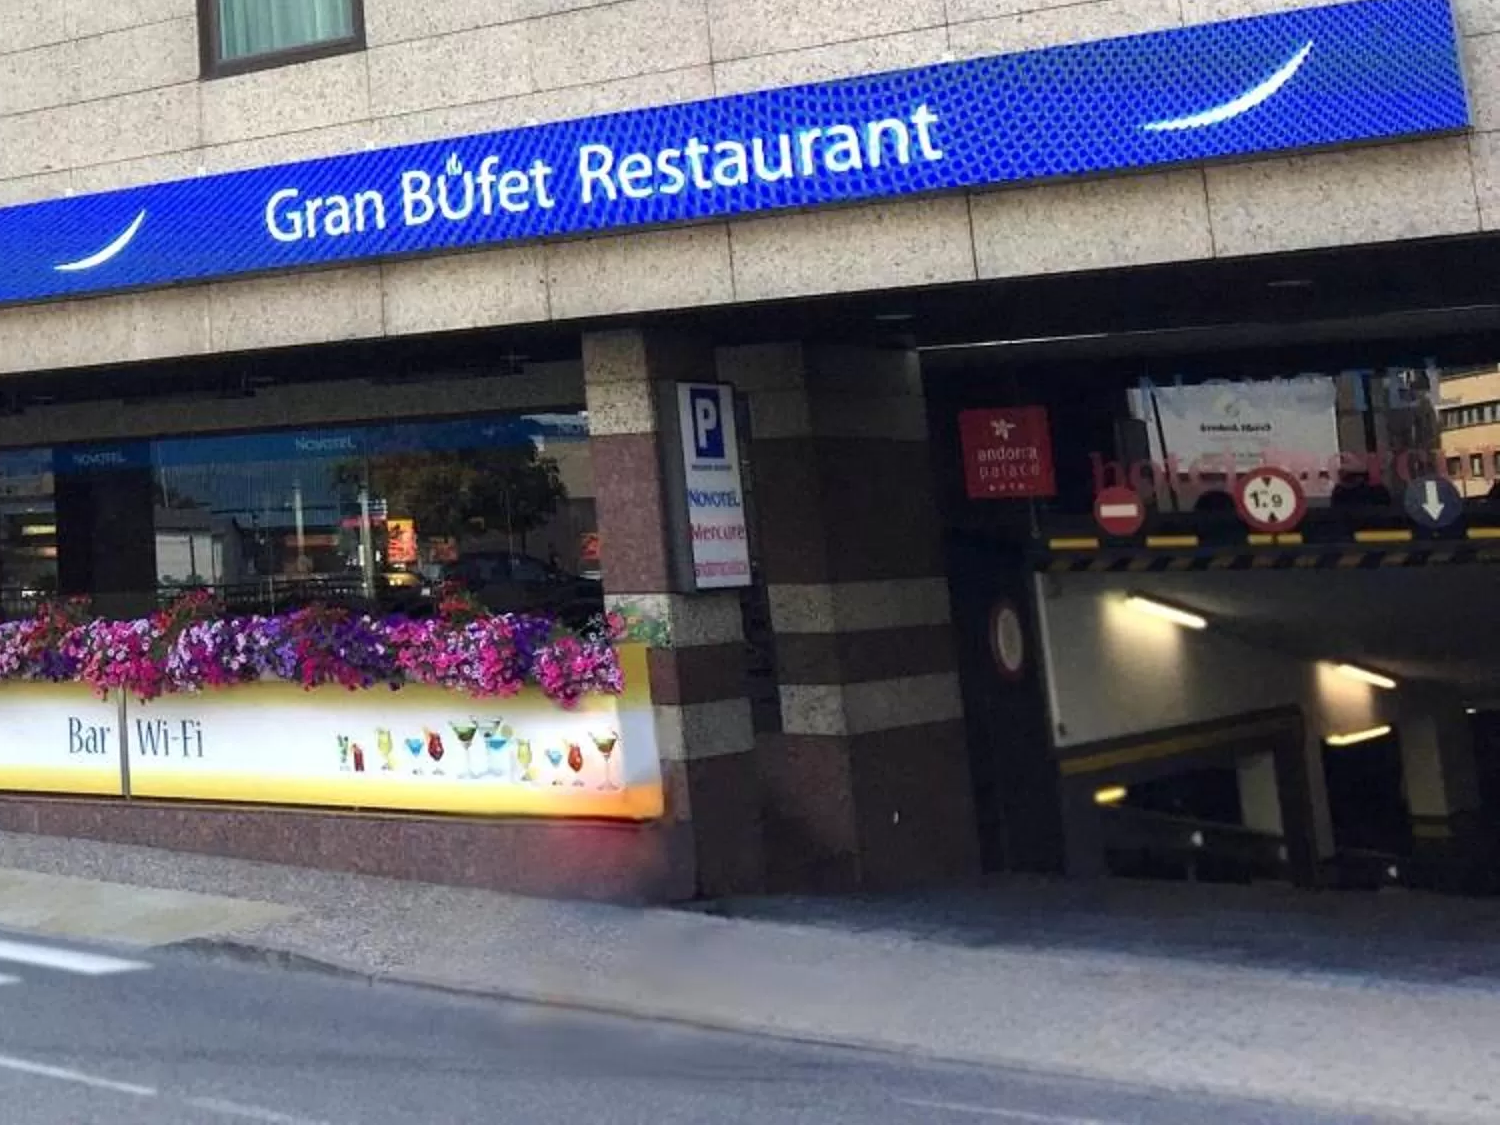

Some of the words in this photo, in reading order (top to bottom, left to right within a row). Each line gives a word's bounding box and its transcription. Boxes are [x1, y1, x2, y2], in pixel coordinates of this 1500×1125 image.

[265, 188, 386, 243] Gran
[577, 103, 944, 204] Restaurant
[695, 398, 717, 449] P
[977, 446, 1037, 461] andorra
[688, 488, 741, 507] NOVOTEL
[689, 524, 746, 543] Mercure
[68, 716, 111, 754] Bar
[136, 718, 204, 757] Wi-Fi
